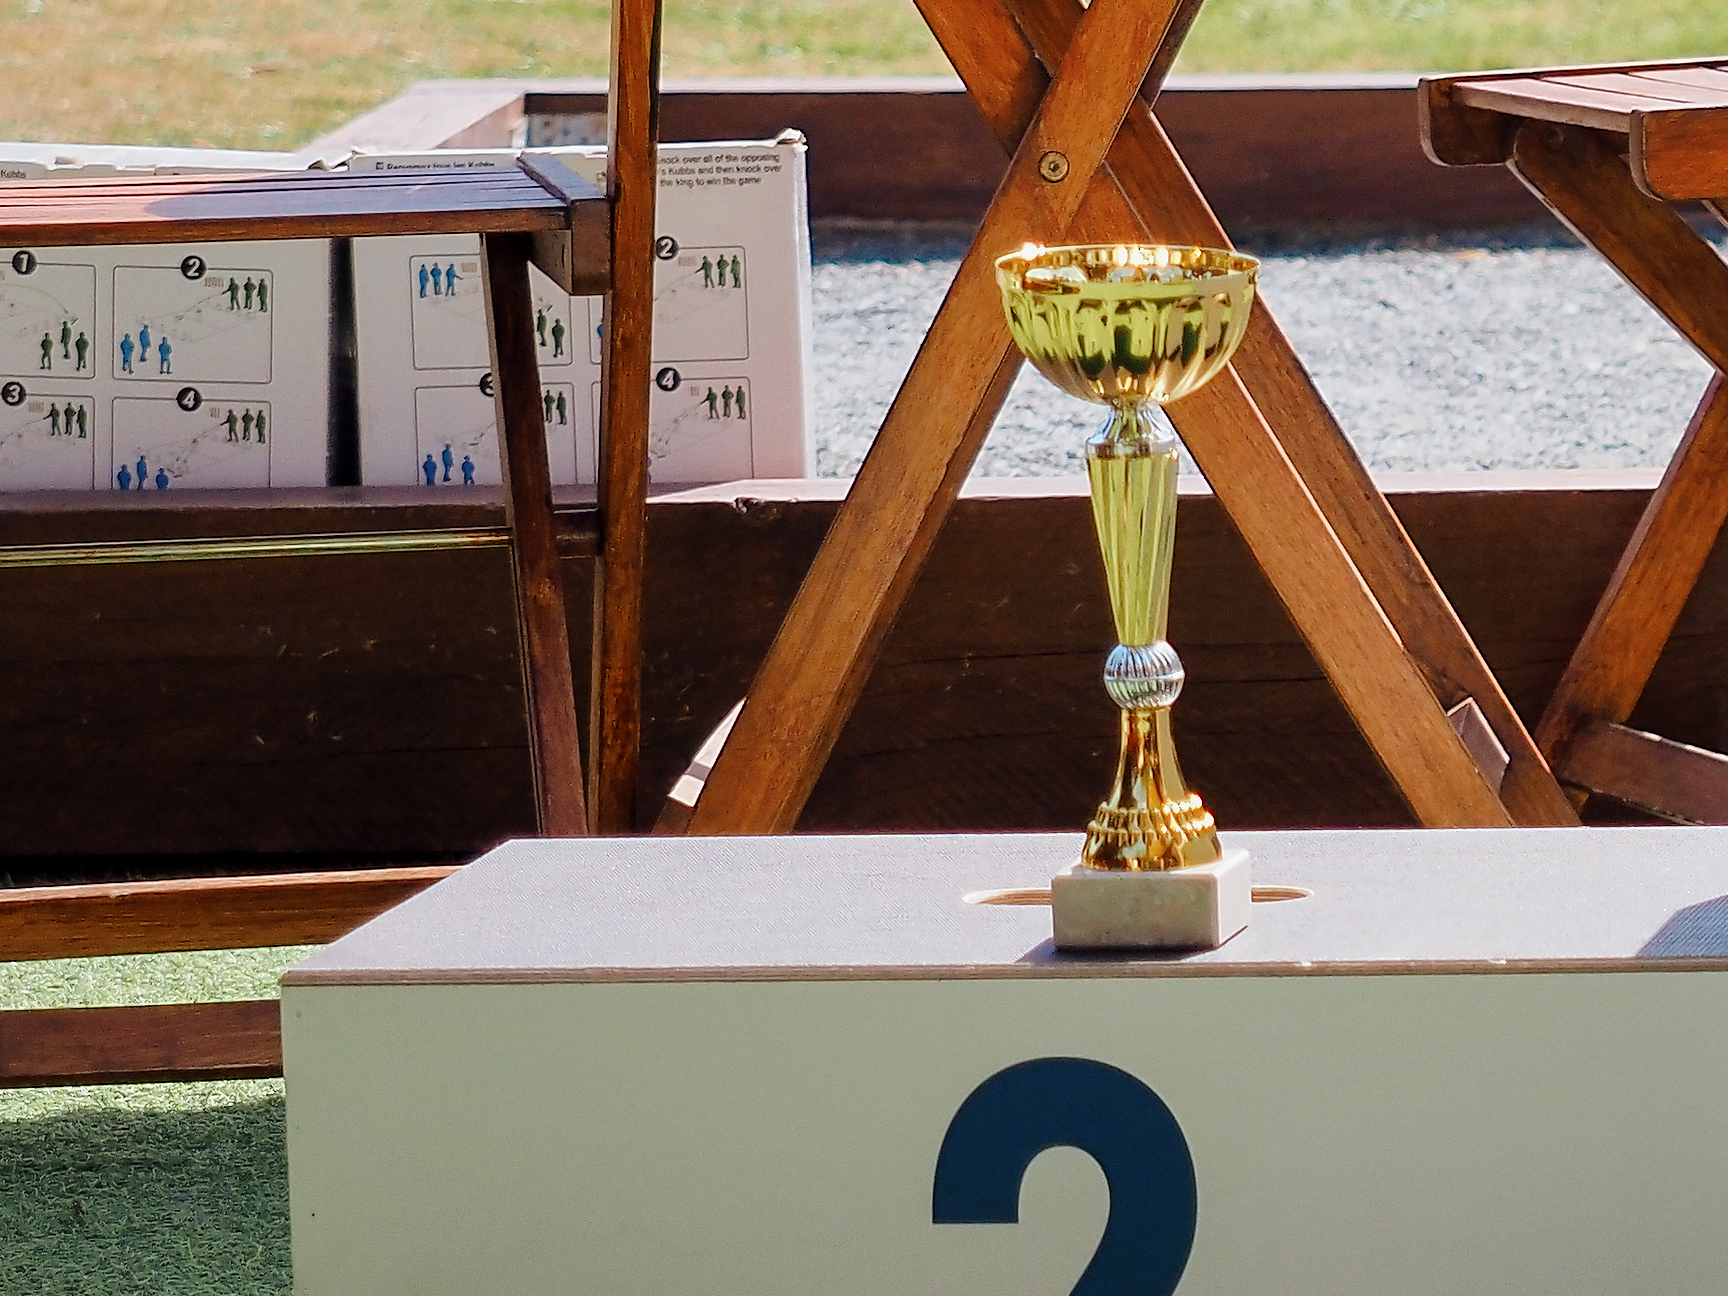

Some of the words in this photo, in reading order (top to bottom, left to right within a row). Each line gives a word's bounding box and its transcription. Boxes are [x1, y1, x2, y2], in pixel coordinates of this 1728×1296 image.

[714, 154, 724, 163] of
[659, 238, 673, 258] 2
[187, 259, 201, 277] 2
[662, 370, 676, 389] 4
[7, 384, 21, 403] 3
[183, 390, 197, 408] 4
